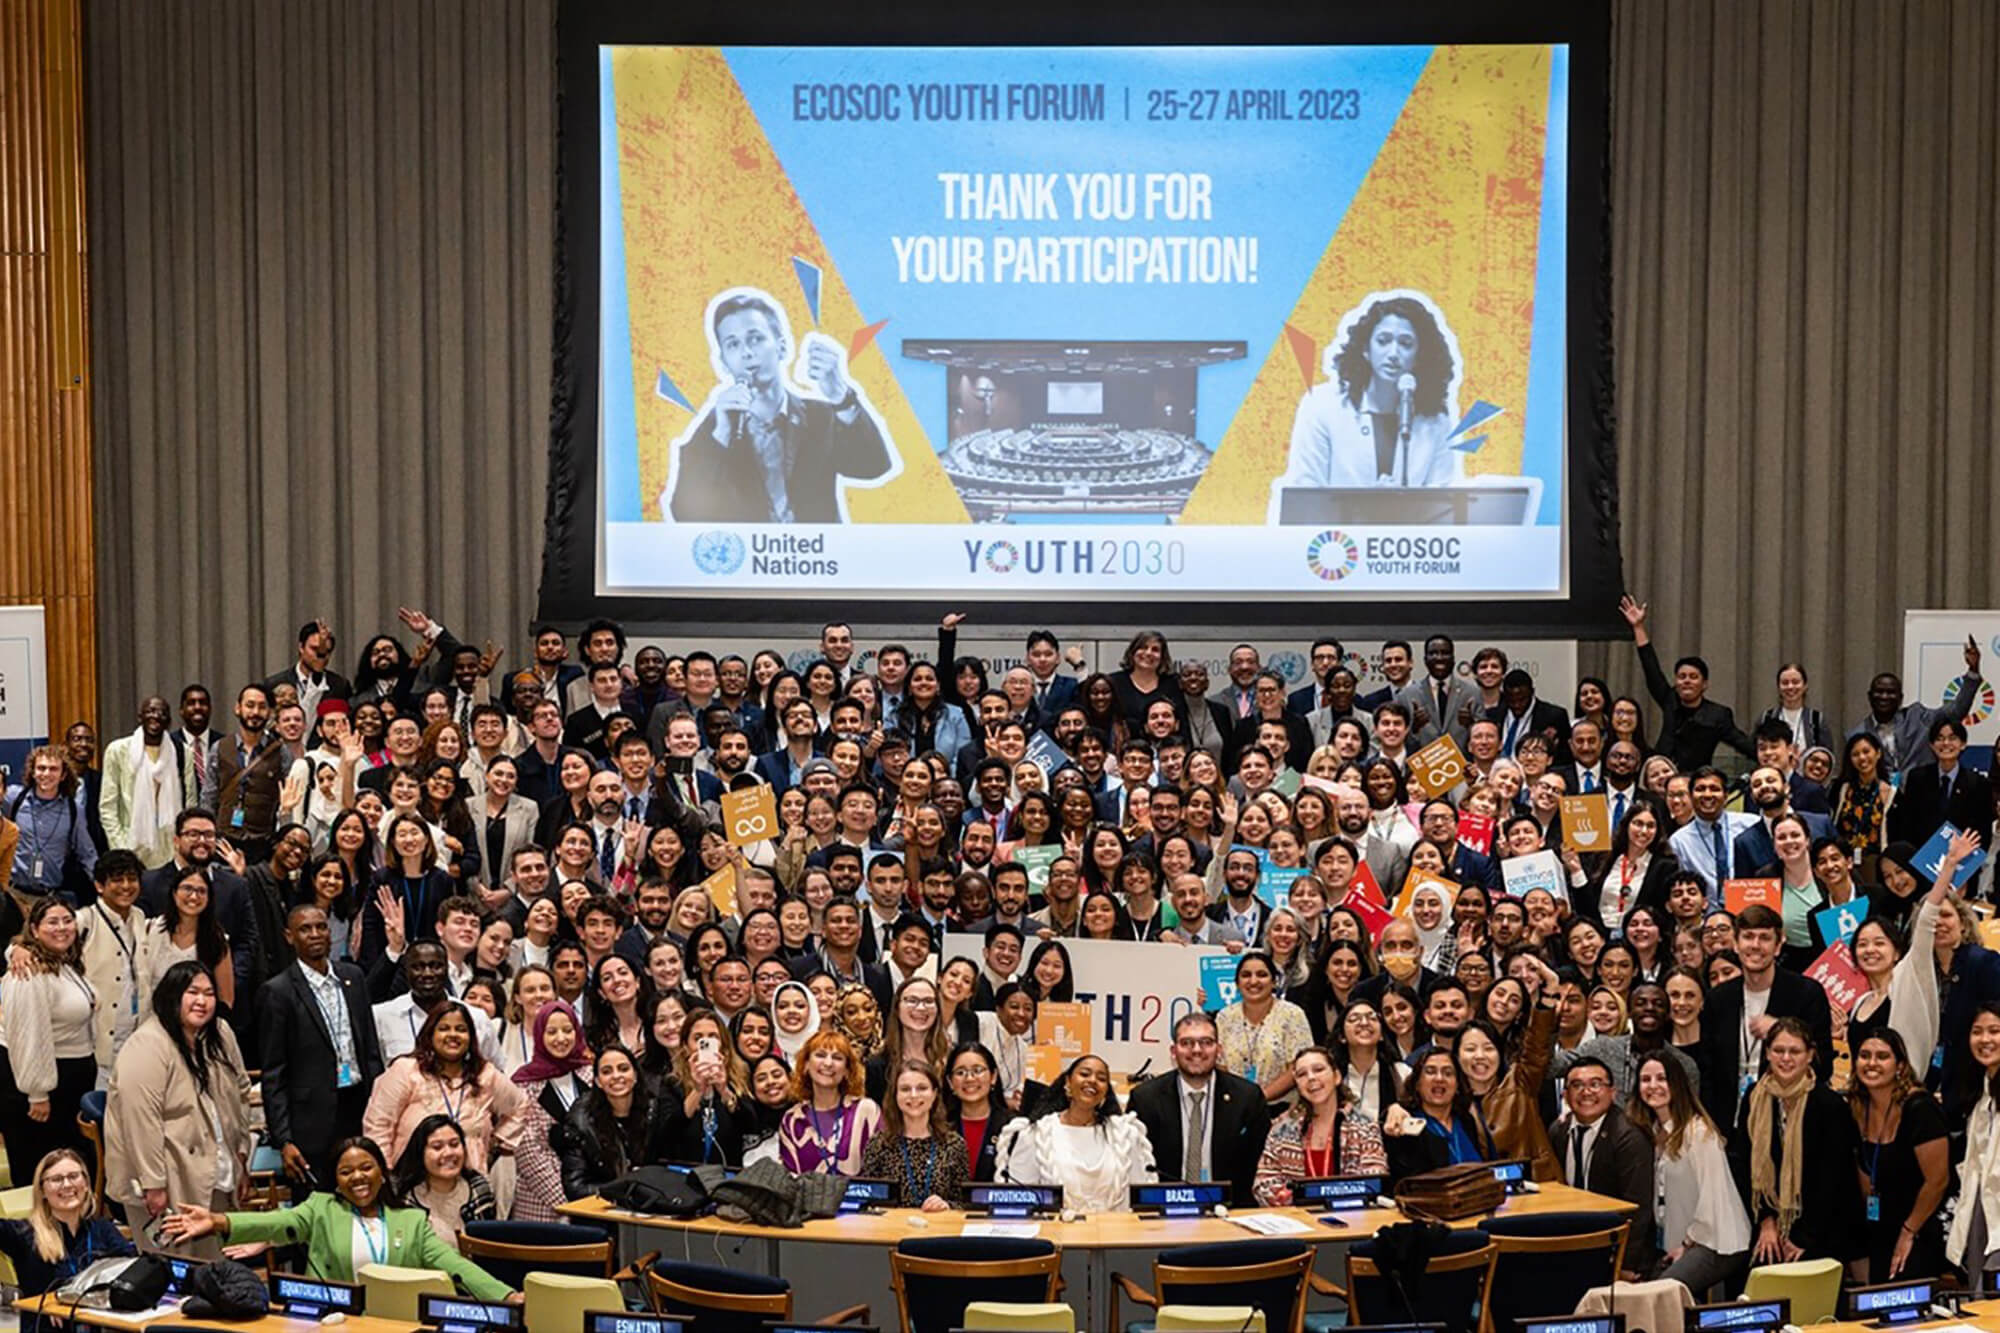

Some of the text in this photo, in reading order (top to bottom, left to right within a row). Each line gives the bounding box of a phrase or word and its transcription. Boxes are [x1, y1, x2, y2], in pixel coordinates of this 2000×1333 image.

[792, 83, 1361, 121] ECOSOC YOUTH FORUM 25-27 APRIL 2023
[938, 172, 1212, 220] THANK YOU FOR
[891, 236, 1259, 283] YOUR PARTICIPATION!
[752, 533, 824, 553] United
[1366, 537, 1461, 559] ECOSOC
[752, 555, 839, 575] Nations
[1366, 561, 1461, 574] YOUTH FORUM
[1165, 1189, 1197, 1203] BRAZIL
[1871, 1287, 1915, 1308] GUATEMALA
